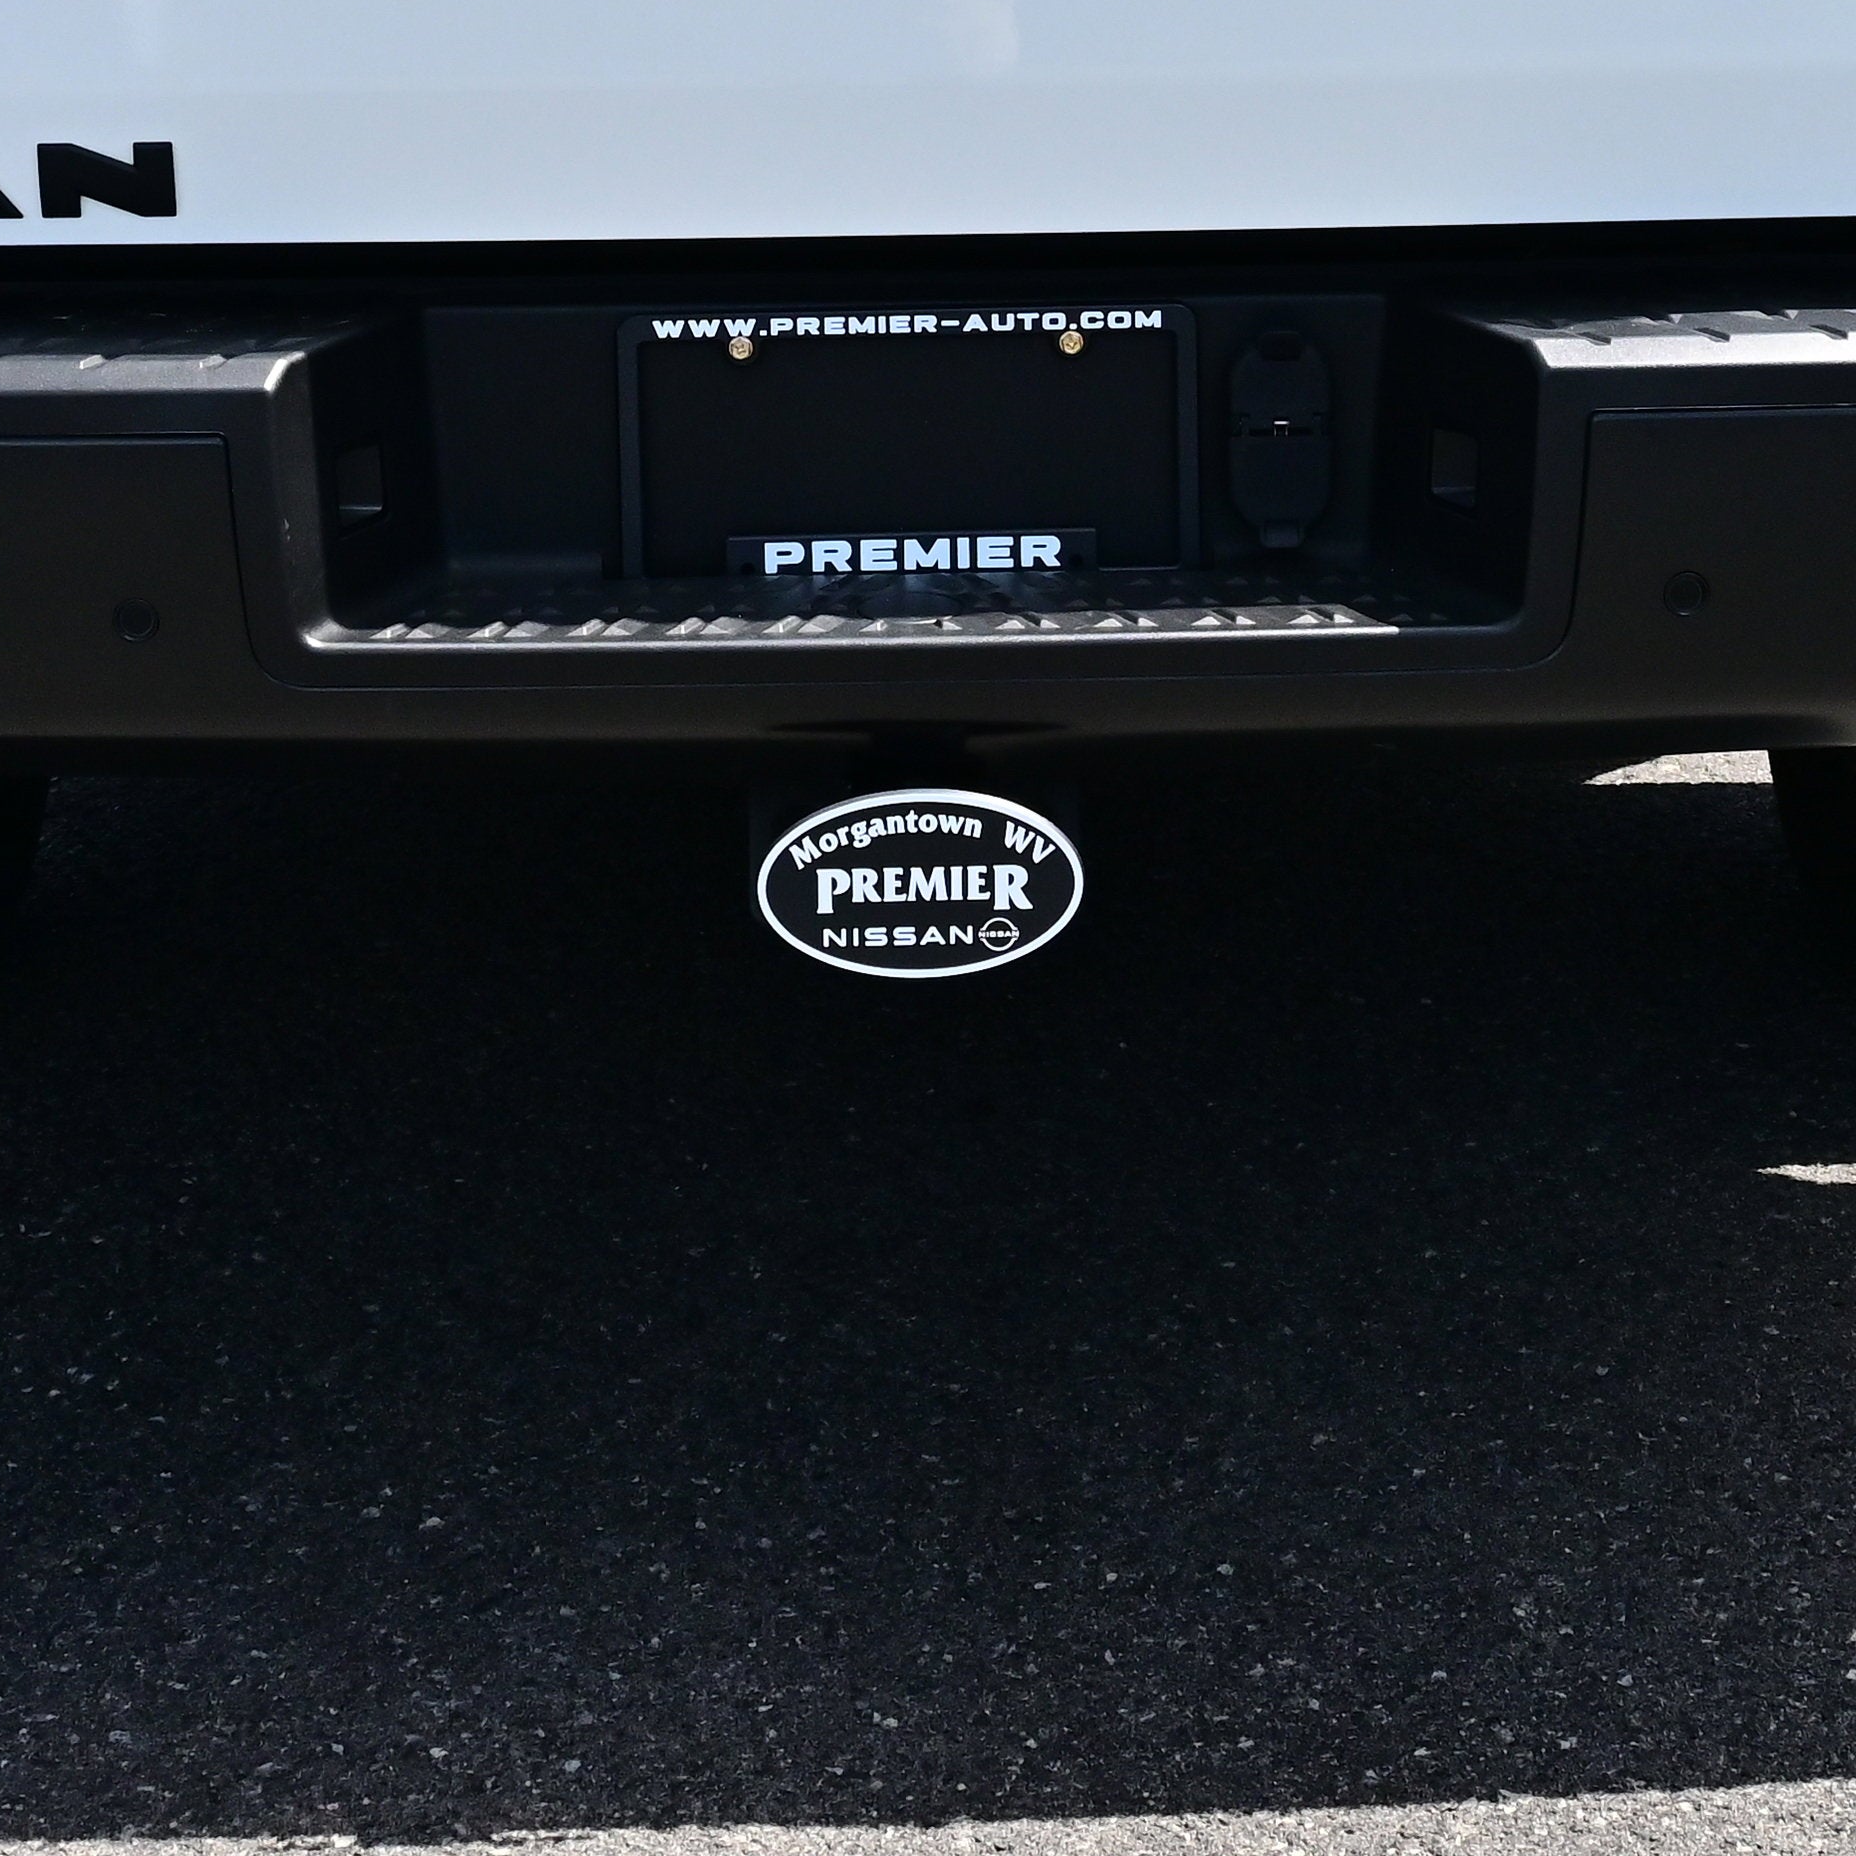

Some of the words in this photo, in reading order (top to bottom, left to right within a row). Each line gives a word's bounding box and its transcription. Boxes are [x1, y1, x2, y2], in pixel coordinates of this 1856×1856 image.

[651, 309, 1163, 339] WWW.PREMIER-AUTO.COM
[763, 534, 1062, 575] PREMIER
[788, 809, 983, 867] Morgantown
[1003, 820, 1057, 864] WV
[815, 863, 1034, 914] PREMIER
[822, 925, 974, 948] NISSAN
[977, 929, 1021, 939] NISSAN
